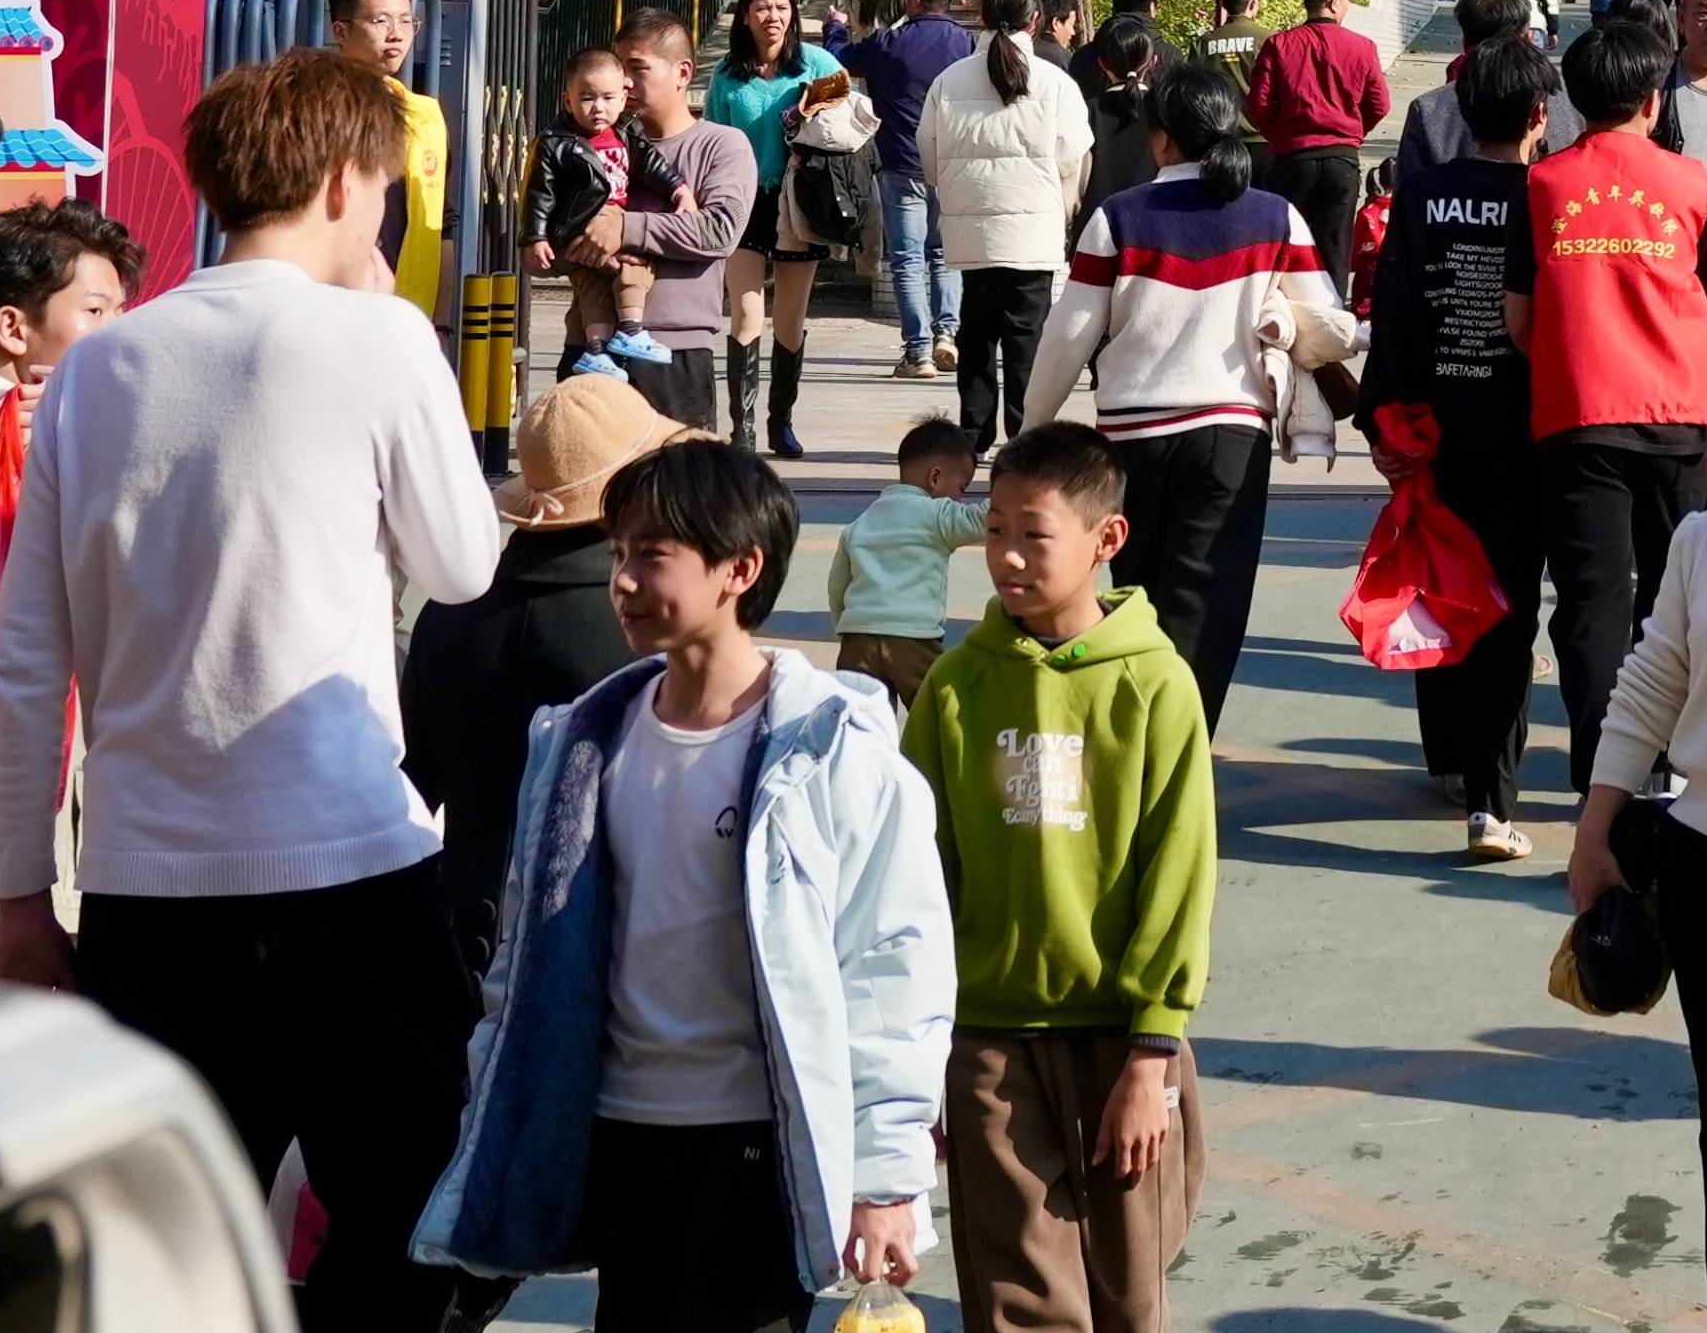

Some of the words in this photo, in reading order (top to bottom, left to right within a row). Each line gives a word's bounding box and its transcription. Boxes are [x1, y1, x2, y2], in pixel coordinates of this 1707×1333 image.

[1208, 36, 1255, 56] BRAVE
[1426, 198, 1509, 227] NALRI
[1552, 237, 1676, 260] 15322602292
[996, 727, 1084, 759] Love
